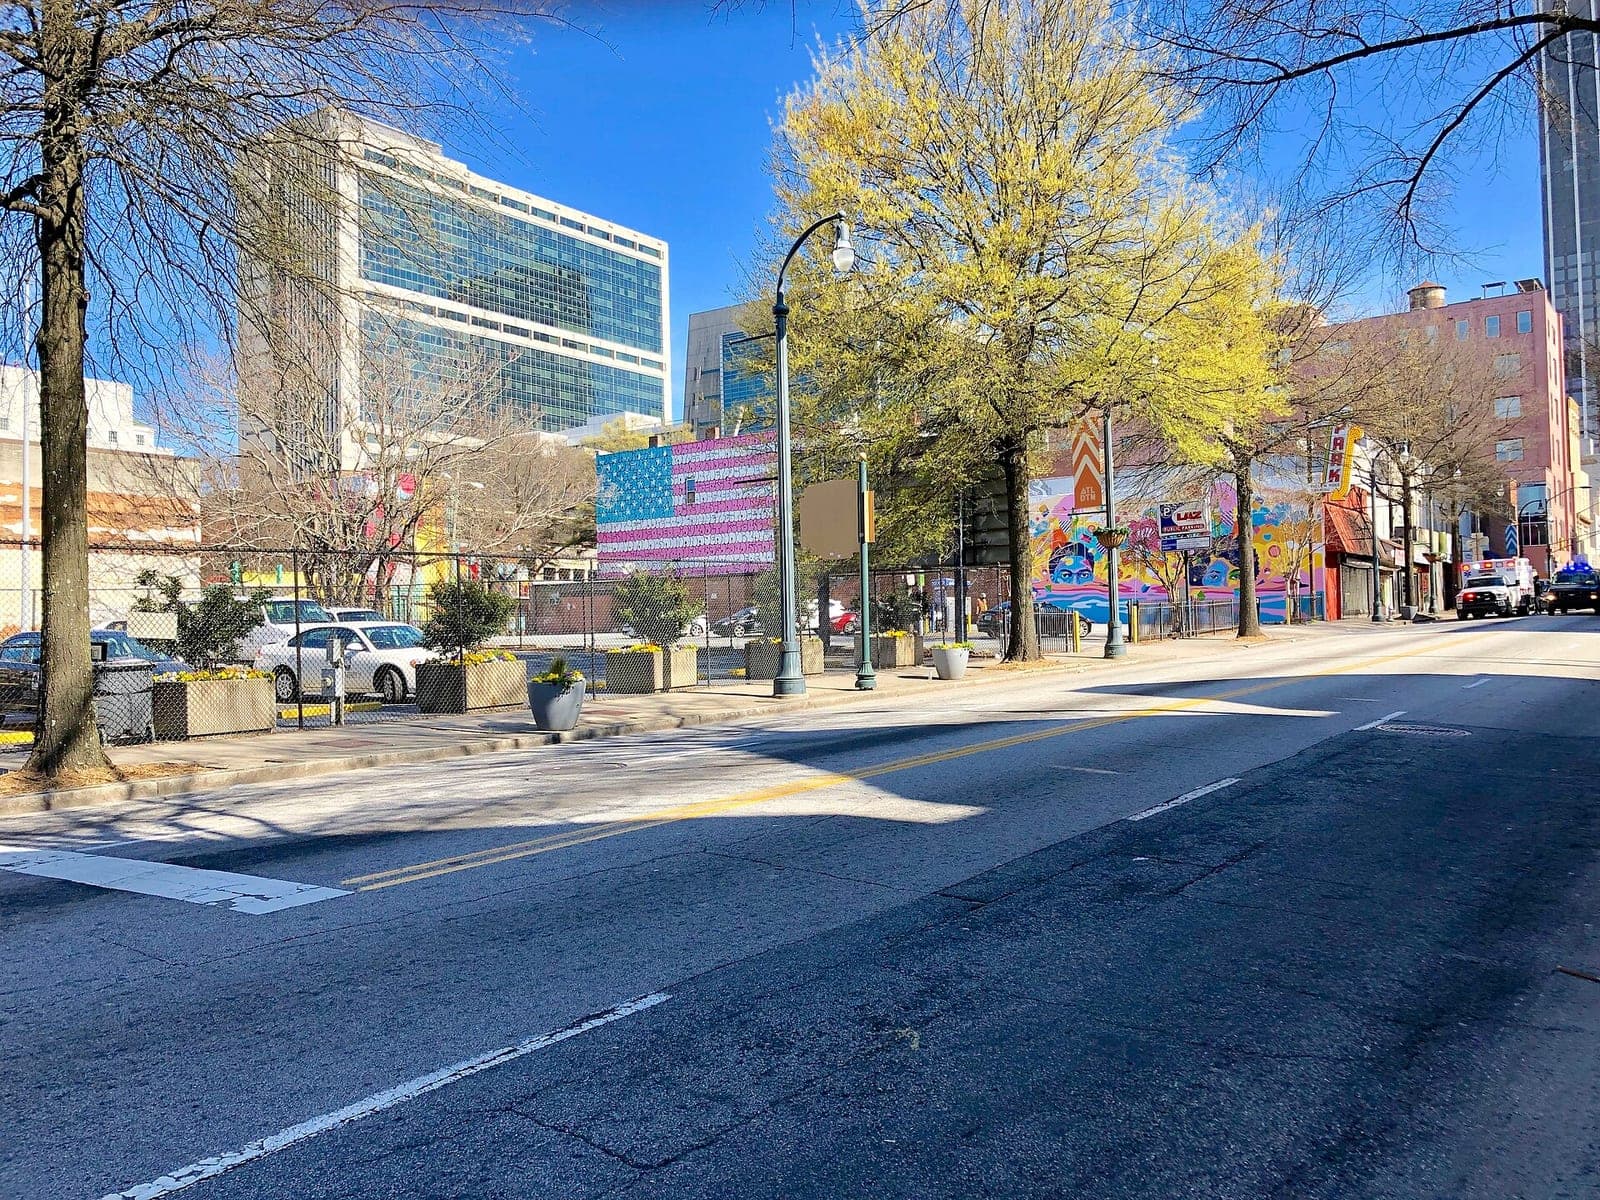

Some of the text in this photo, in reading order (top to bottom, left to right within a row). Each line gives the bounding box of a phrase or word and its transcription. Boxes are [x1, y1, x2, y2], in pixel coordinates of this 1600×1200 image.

[1080, 486, 1096, 494] ATL
[1163, 507, 1170, 517] P
[1177, 511, 1201, 520] LAZ
